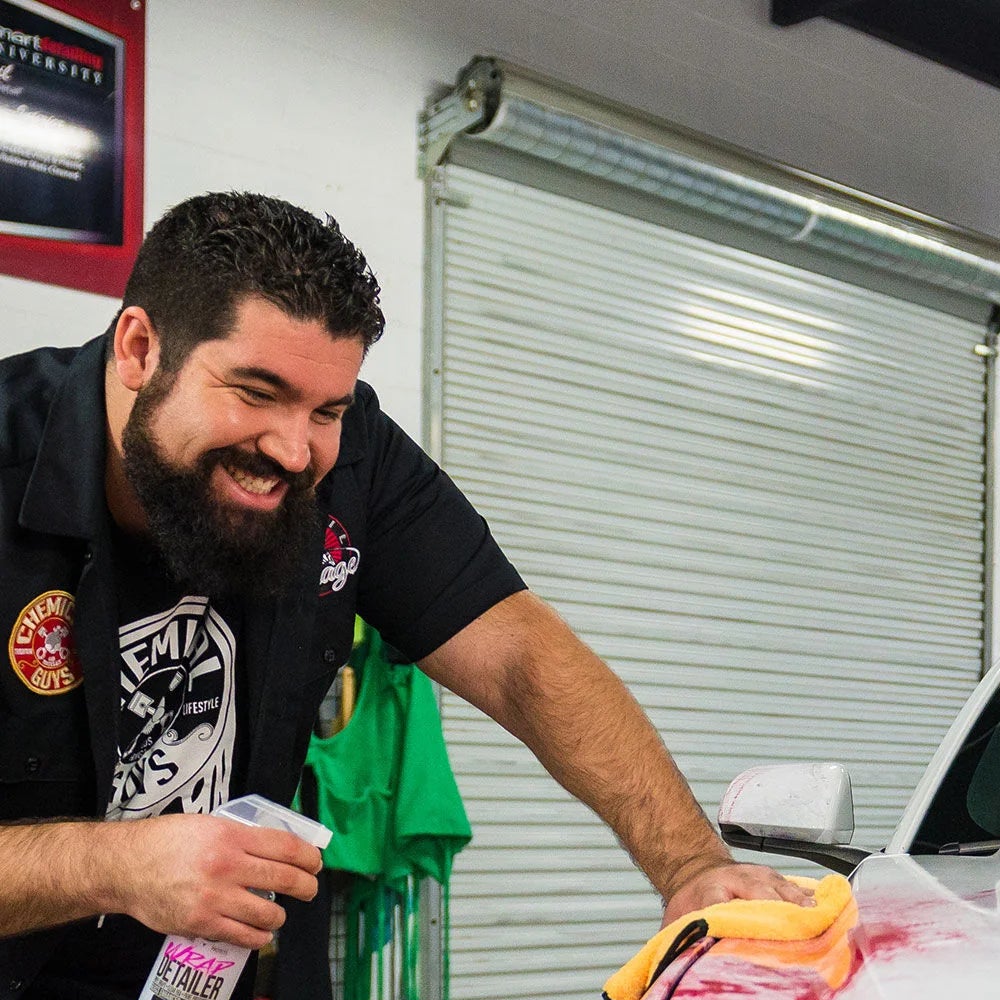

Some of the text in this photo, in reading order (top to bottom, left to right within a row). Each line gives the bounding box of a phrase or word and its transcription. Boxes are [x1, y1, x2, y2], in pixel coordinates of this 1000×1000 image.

[15, 596, 76, 645] CHEMIC
[31, 666, 76, 690] GUYS
[182, 696, 219, 715] LIFESTYLE
[164, 941, 235, 976] WRAP
[156, 956, 224, 1000] DETAILER
